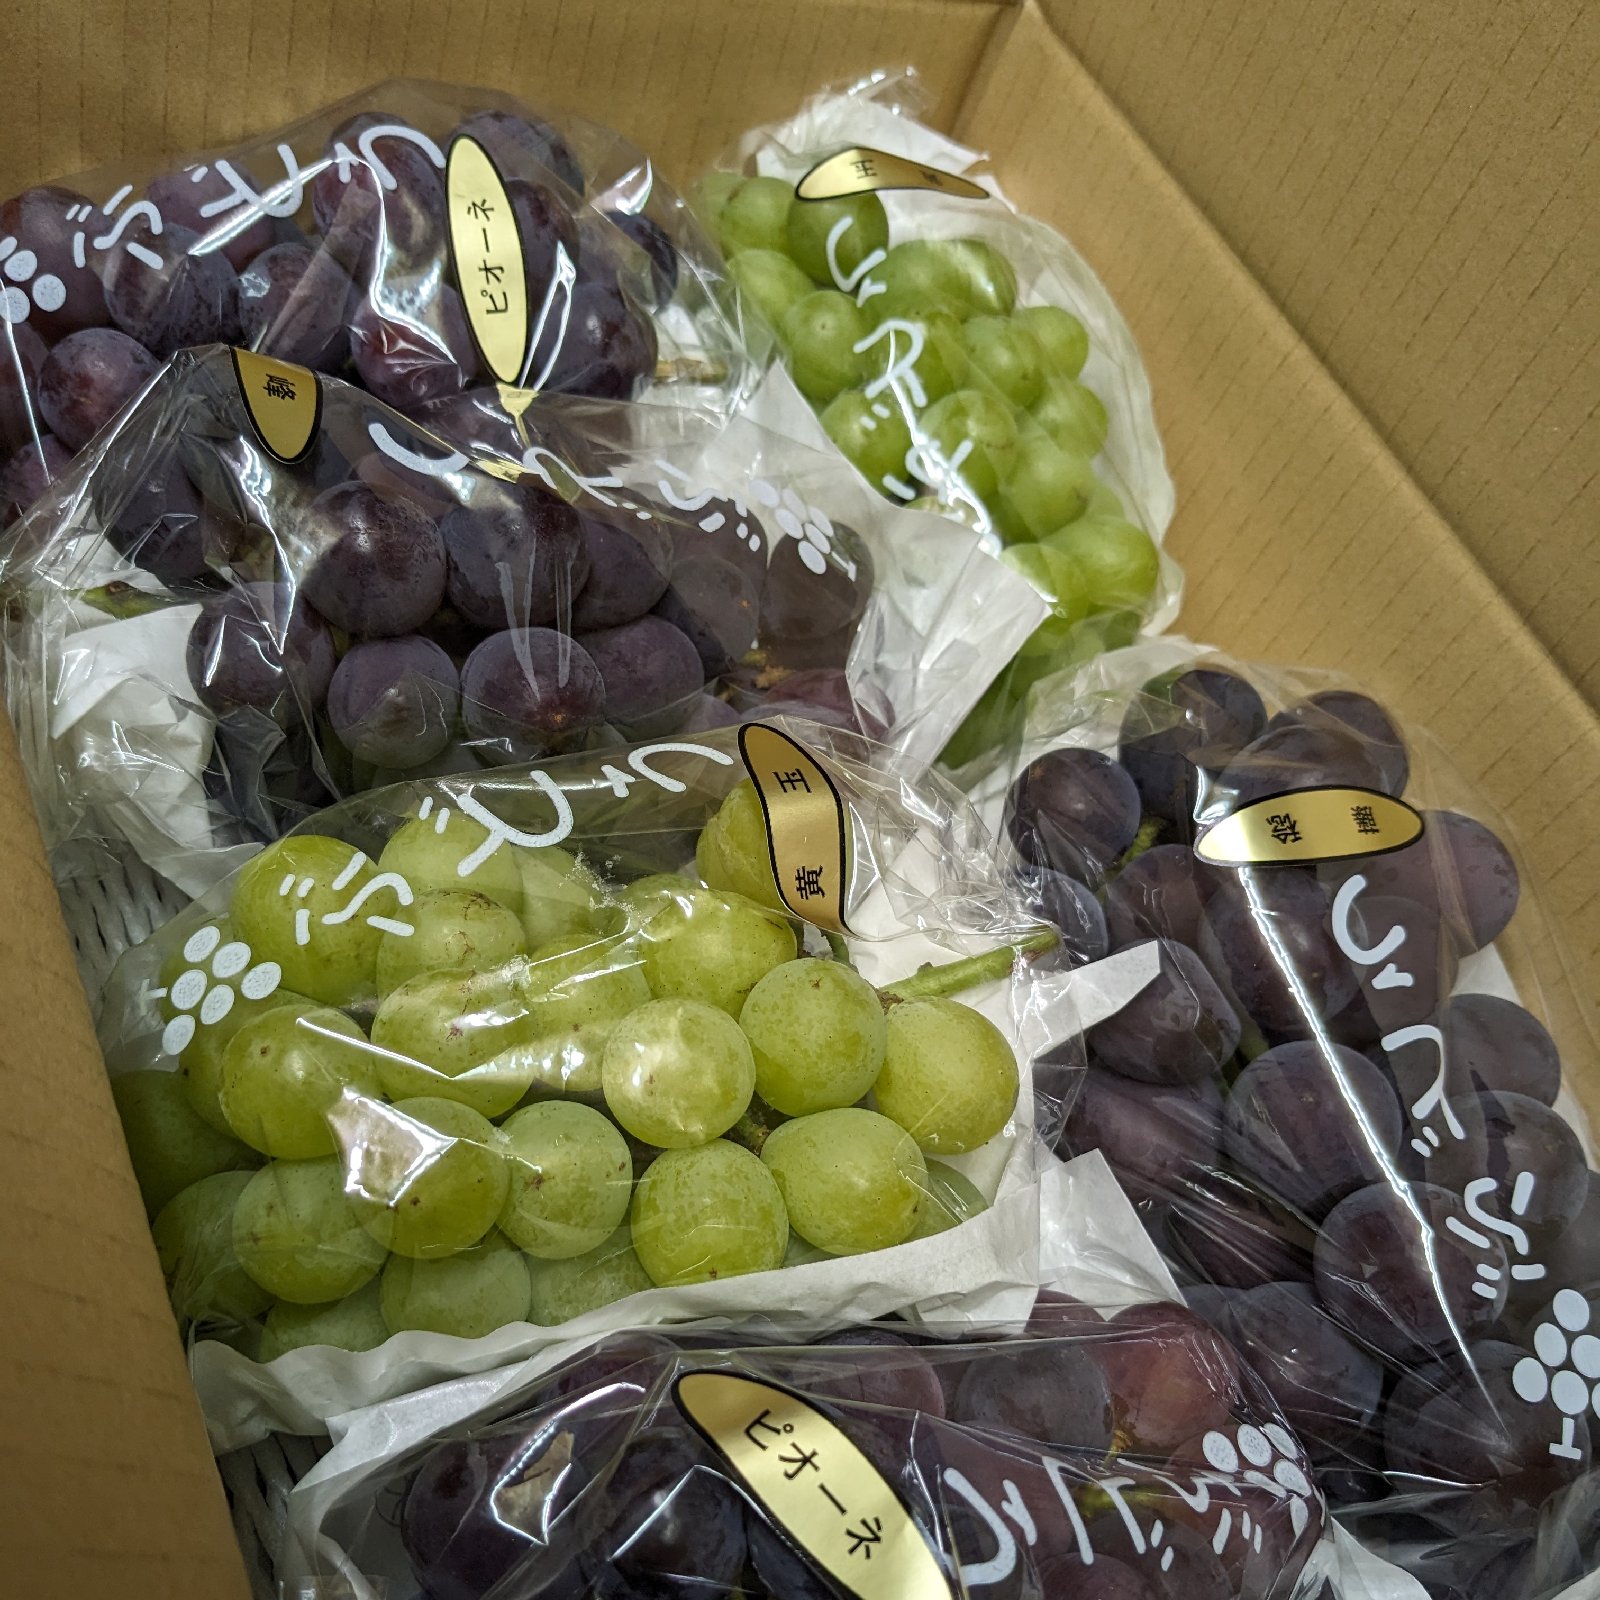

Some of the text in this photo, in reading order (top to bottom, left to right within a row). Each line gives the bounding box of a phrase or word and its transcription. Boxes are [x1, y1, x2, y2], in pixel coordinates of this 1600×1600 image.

[65, 124, 448, 270] ぶどう
[467, 198, 509, 316] ピオーネ
[279, 742, 734, 945] ぶどう
[772, 767, 825, 900] 黄玉
[1331, 873, 1547, 1299] ぶどう
[743, 1408, 885, 1561] ピオーネ
